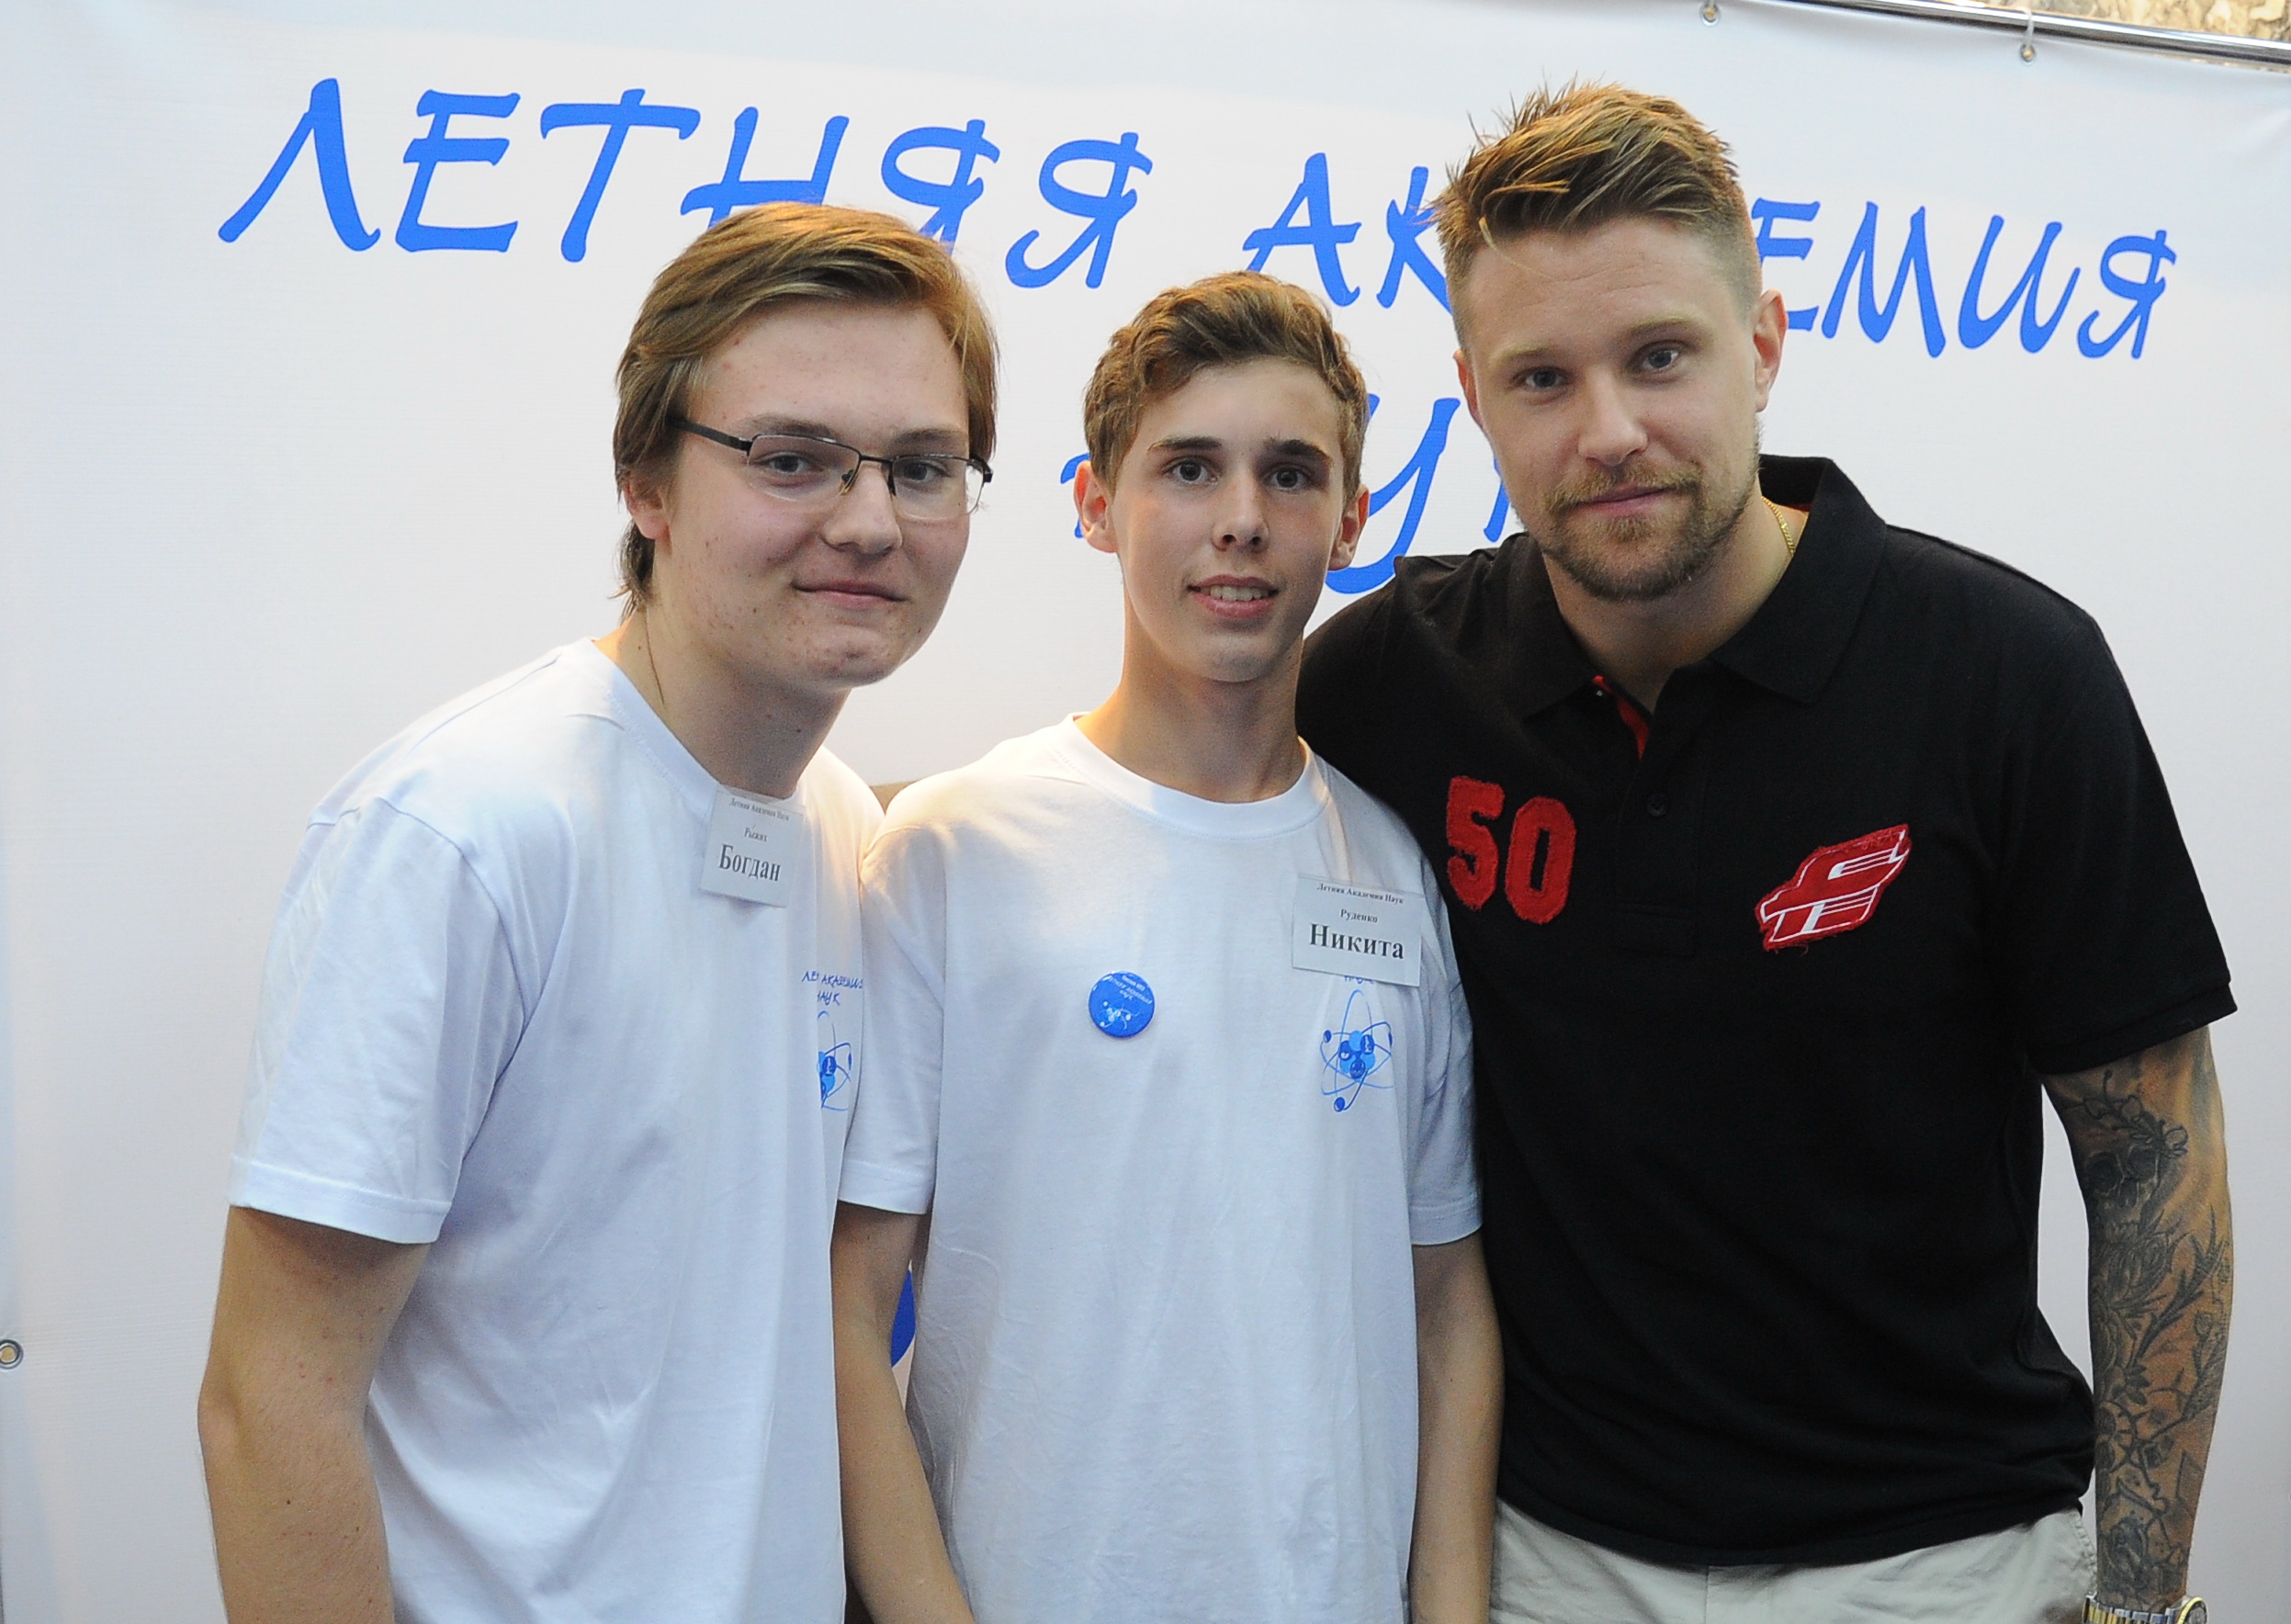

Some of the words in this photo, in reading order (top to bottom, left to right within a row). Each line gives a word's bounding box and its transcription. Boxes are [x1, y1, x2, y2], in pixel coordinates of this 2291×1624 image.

[218, 77, 1153, 289] ЛЕТНЯЯ
[1242, 152, 2177, 359] АКЕМИЯ
[718, 843, 781, 882] Богдан
[1446, 775, 1577, 924] 50
[1317, 883, 1345, 895] Летняя
[1346, 887, 1383, 901] Академия
[1384, 894, 1405, 905] Наук
[1339, 908, 1378, 924] Руденко
[1309, 922, 1405, 960] Никита
